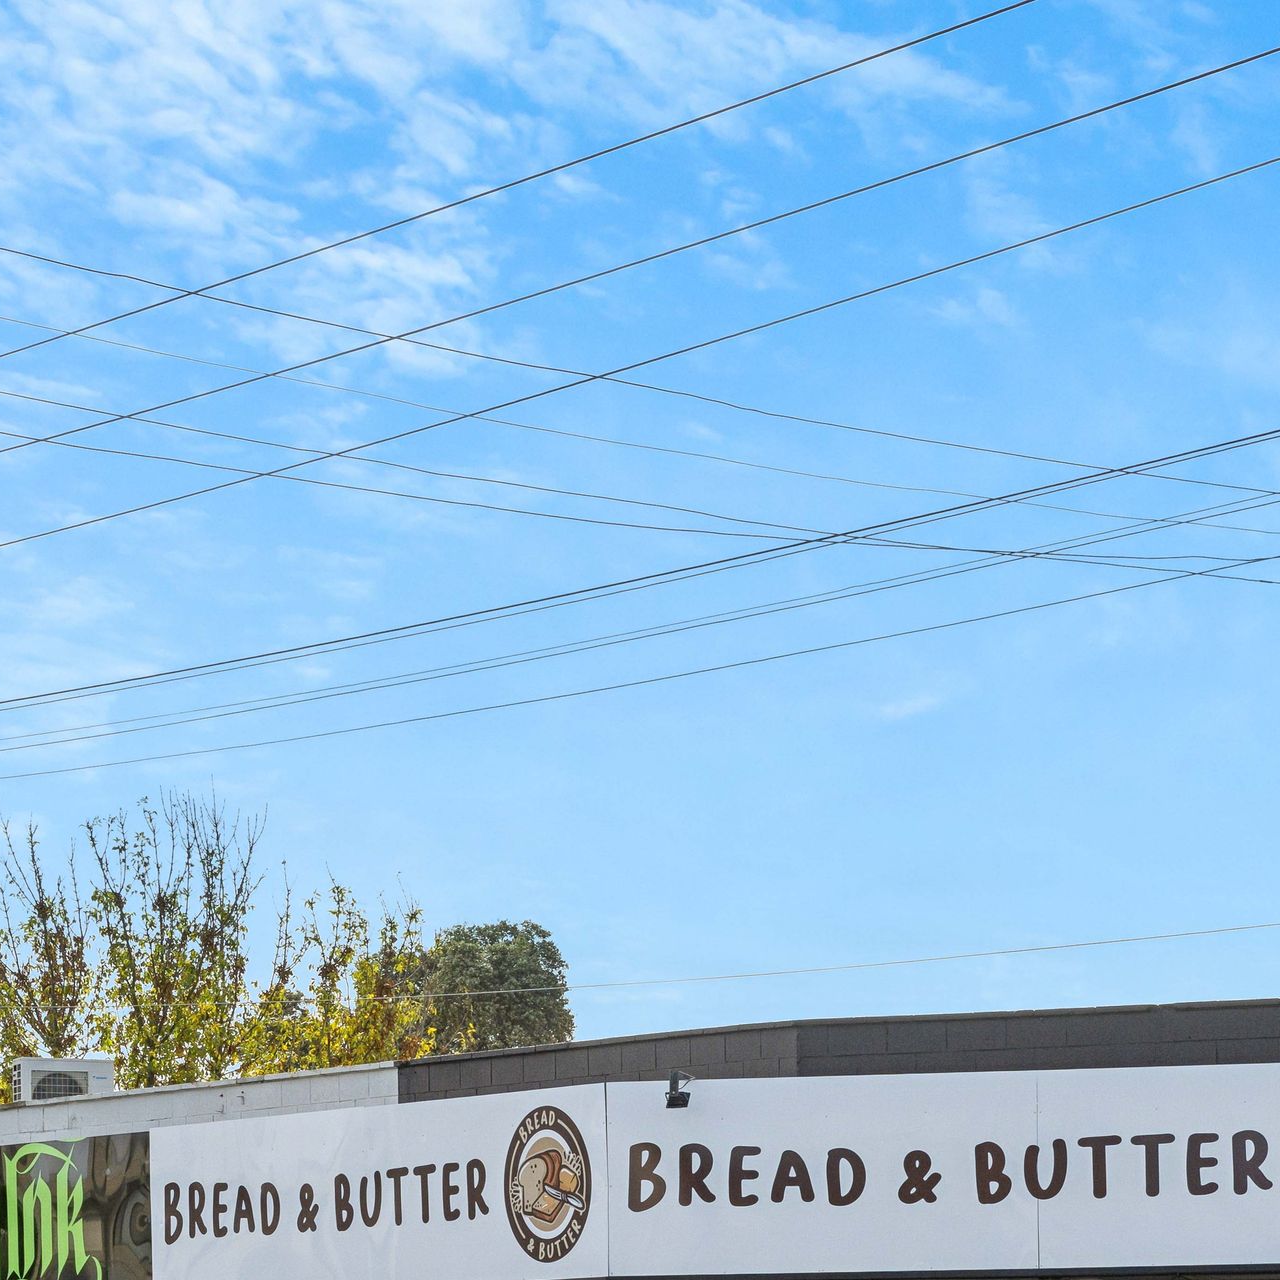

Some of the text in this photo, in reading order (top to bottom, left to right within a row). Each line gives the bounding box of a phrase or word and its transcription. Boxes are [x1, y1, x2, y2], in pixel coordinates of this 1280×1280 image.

[518, 1110, 555, 1144] BREAD
[627, 1129, 1273, 1212] BREAD & BUTTER
[163, 1158, 489, 1246] BREAD & BUTTER
[527, 1219, 581, 1260] & BUTTER
